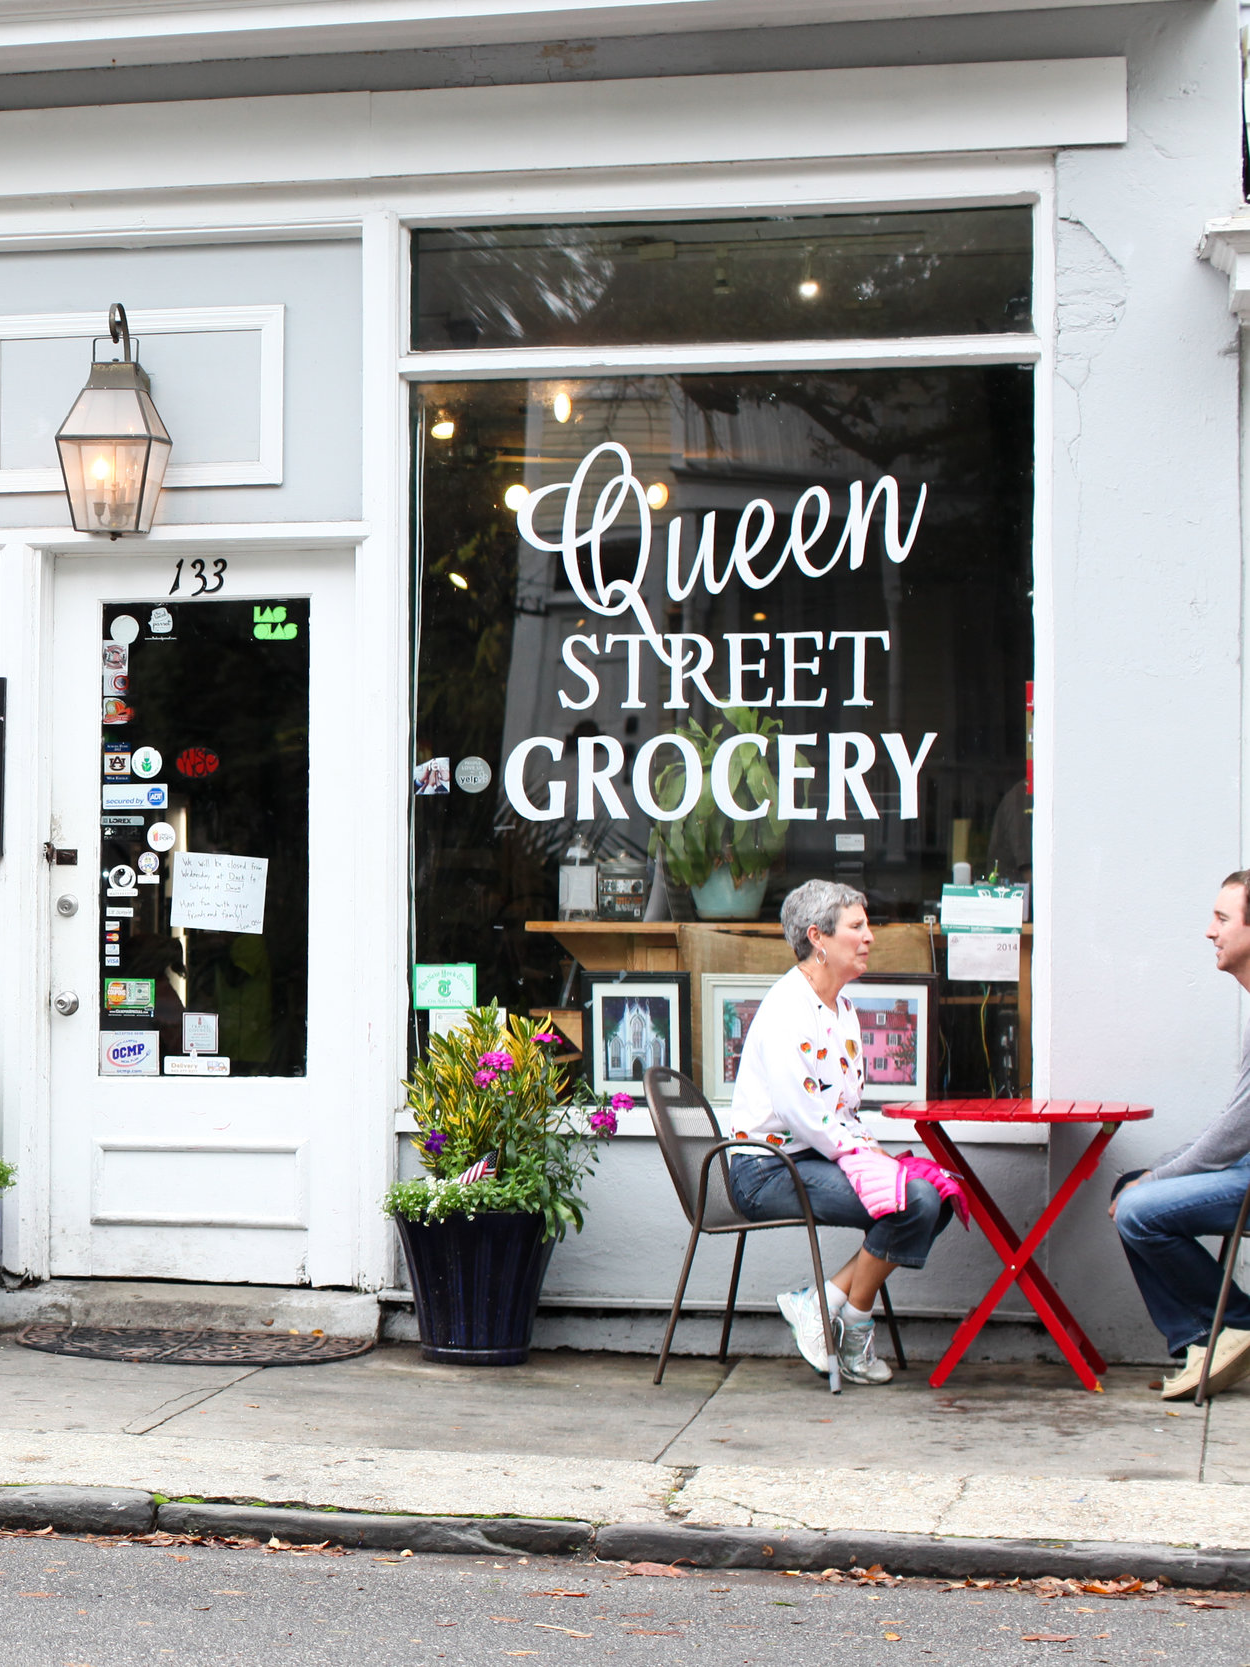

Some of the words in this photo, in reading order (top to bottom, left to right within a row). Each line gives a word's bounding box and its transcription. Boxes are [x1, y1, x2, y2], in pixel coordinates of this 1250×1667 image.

[516, 441, 928, 667] Queen
[169, 557, 228, 596] 133
[253, 605, 287, 623] LAS
[253, 622, 298, 640] OLAS
[557, 630, 891, 710] STREET
[460, 775, 479, 785] yelp
[503, 731, 938, 822] GROCERY
[105, 797, 134, 805] secured
[135, 797, 145, 806] by
[149, 792, 163, 801] ADT
[198, 858, 210, 867] will
[227, 860, 247, 870] closed
[215, 900, 230, 908] with
[997, 943, 1018, 952] 2014
[112, 1043, 145, 1060] OCMP
